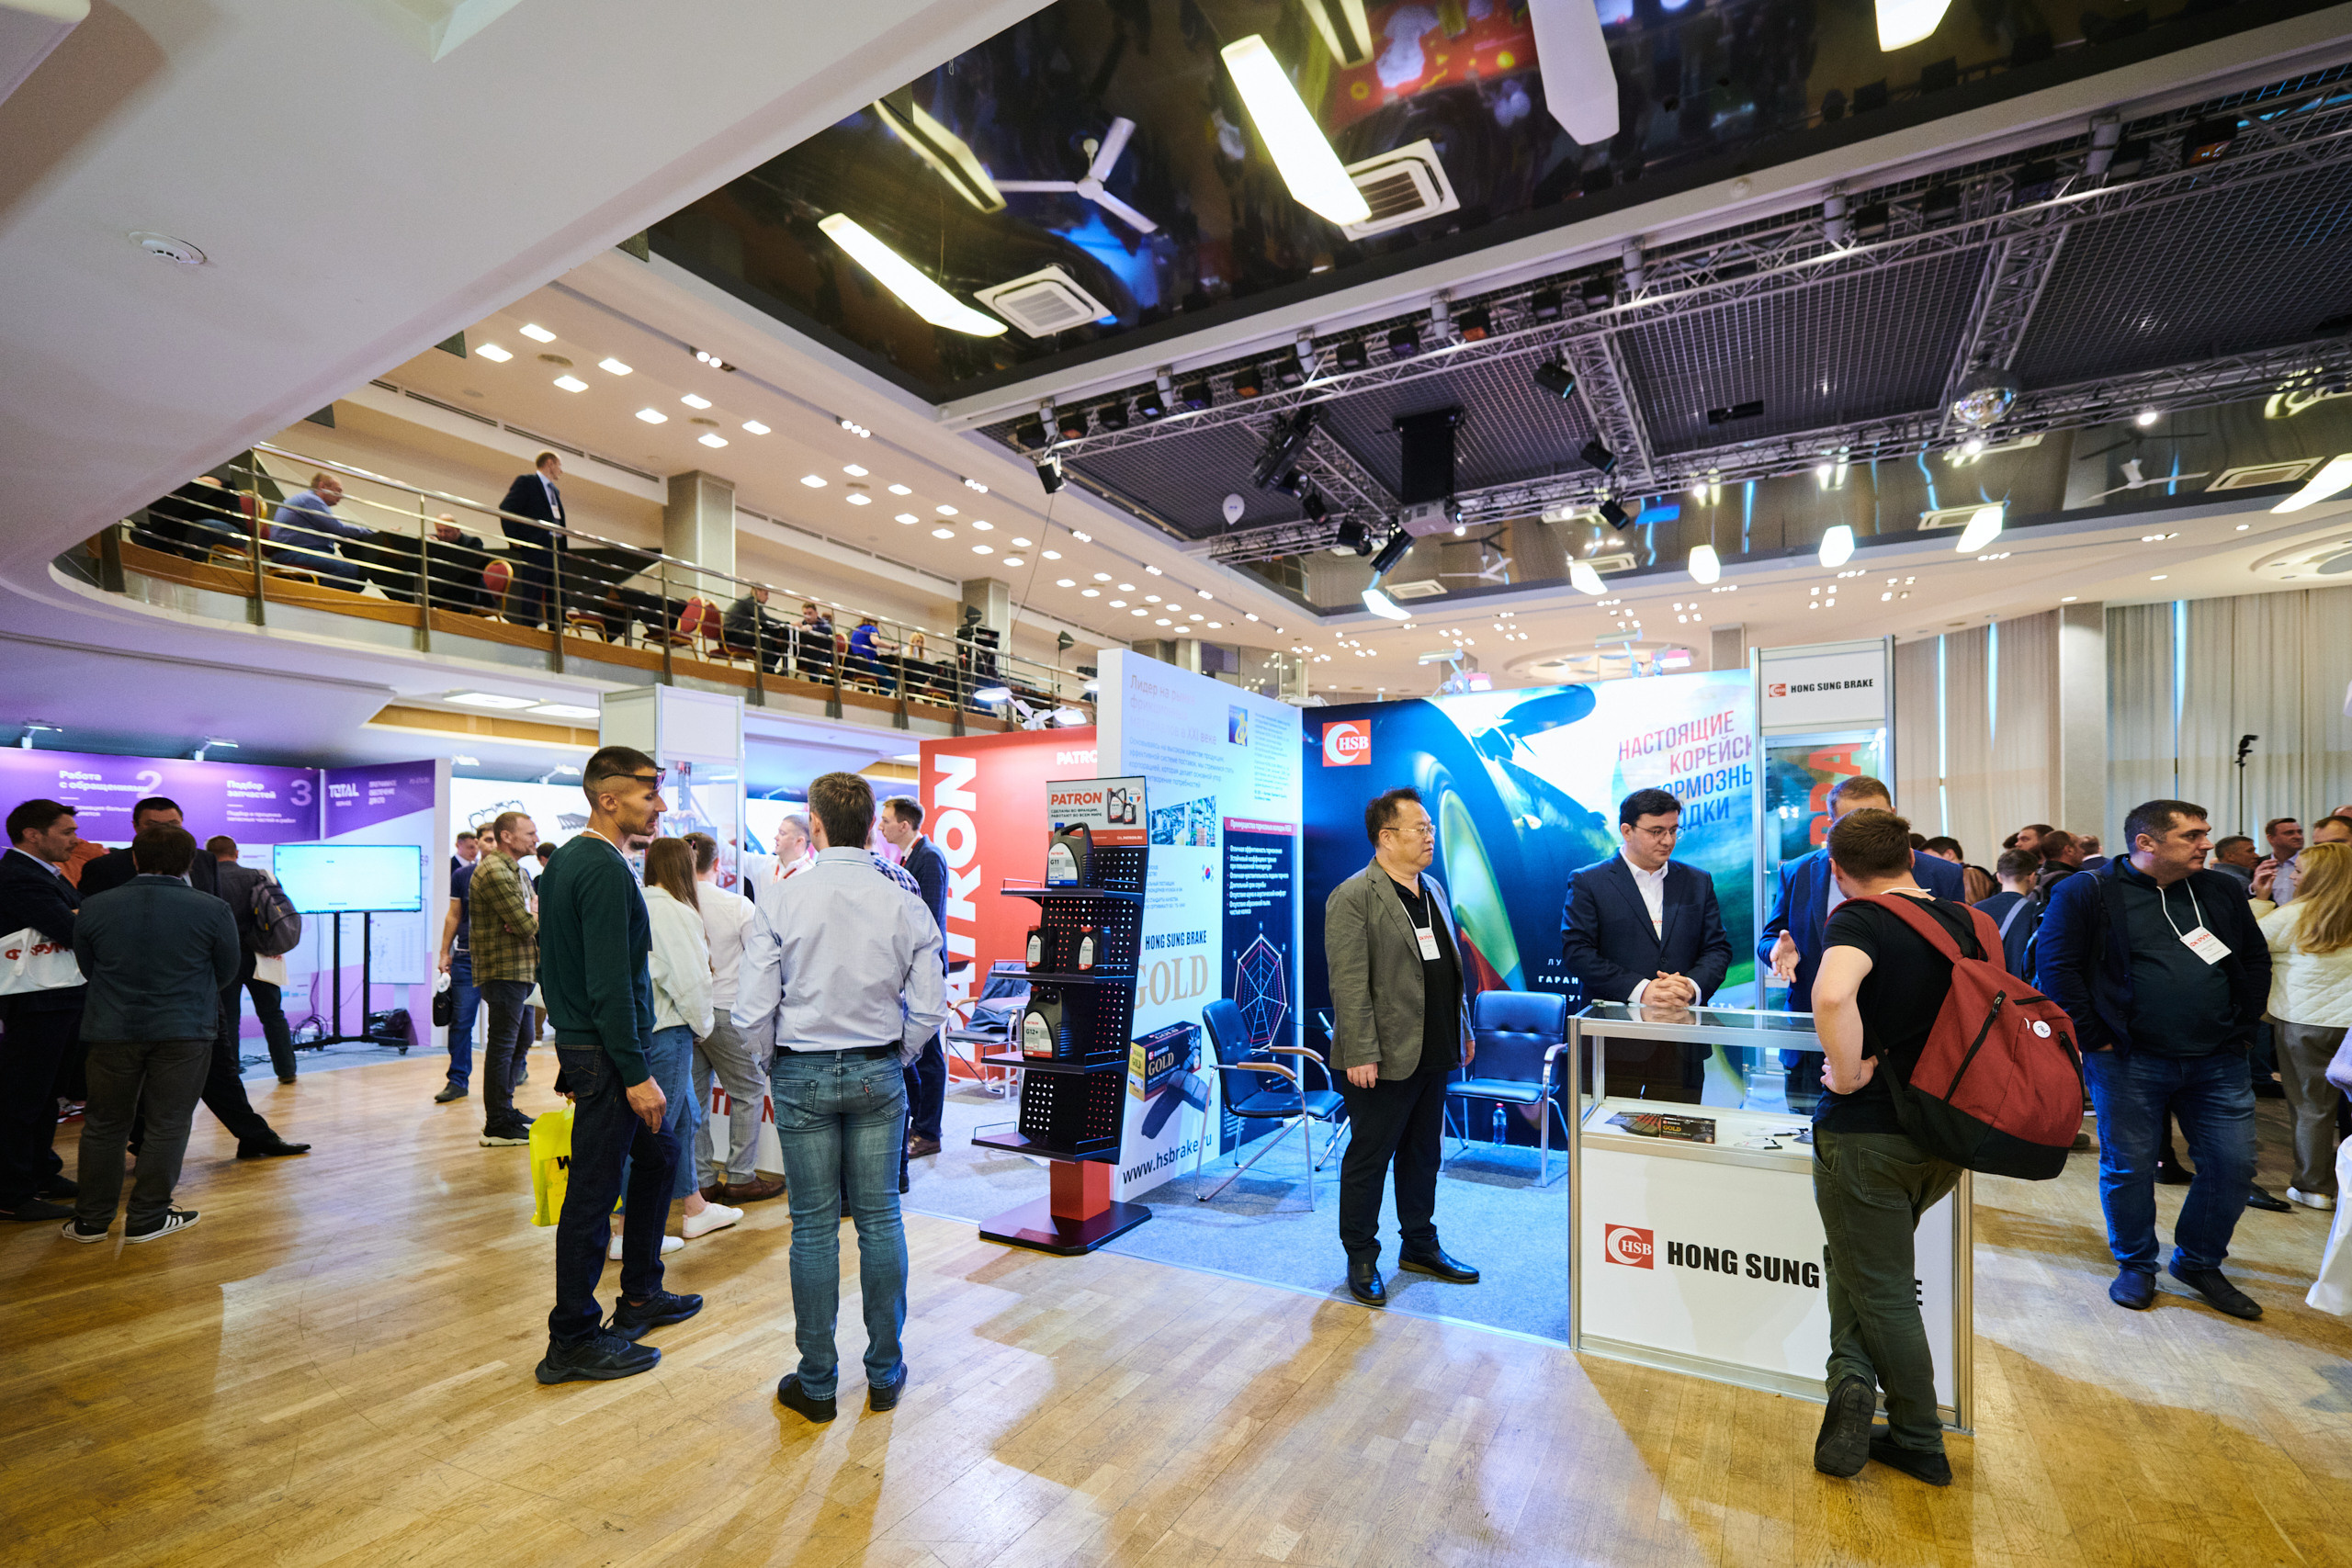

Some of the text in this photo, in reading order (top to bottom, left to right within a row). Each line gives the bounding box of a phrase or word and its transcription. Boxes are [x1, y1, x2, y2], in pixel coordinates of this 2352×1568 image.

[1130, 674, 1158, 698] Лидер
[1159, 686, 1170, 698] на
[1791, 679, 1873, 694] HONG SUNG BRAKE
[1200, 732, 1217, 745] веке
[1339, 736, 1369, 751] HSB
[1619, 710, 1735, 761] НАСТОЯЩИЕ
[1057, 750, 1098, 765] PATRO
[1670, 734, 1752, 775] КОРЕЙСК
[59, 770, 102, 781] Работа
[59, 781, 68, 789] с
[136, 770, 164, 799] 2
[226, 780, 265, 792] Подбор
[289, 779, 312, 807] 3
[226, 790, 277, 799] запчастей
[1051, 792, 1102, 806] PATRON
[1145, 930, 1207, 951] HONG SUNG BRAKE
[1135, 954, 1208, 1010] GOLD
[1538, 975, 1579, 985] ГАРАН
[1148, 1052, 1175, 1077] GOLD
[1662, 1124, 1682, 1133] GOLD
[1123, 1134, 1212, 1185] www.hsbrakeu
[1621, 1238, 1653, 1257] HSB
[1667, 1241, 1738, 1276] HONG
[1745, 1253, 1820, 1289] SUNG
